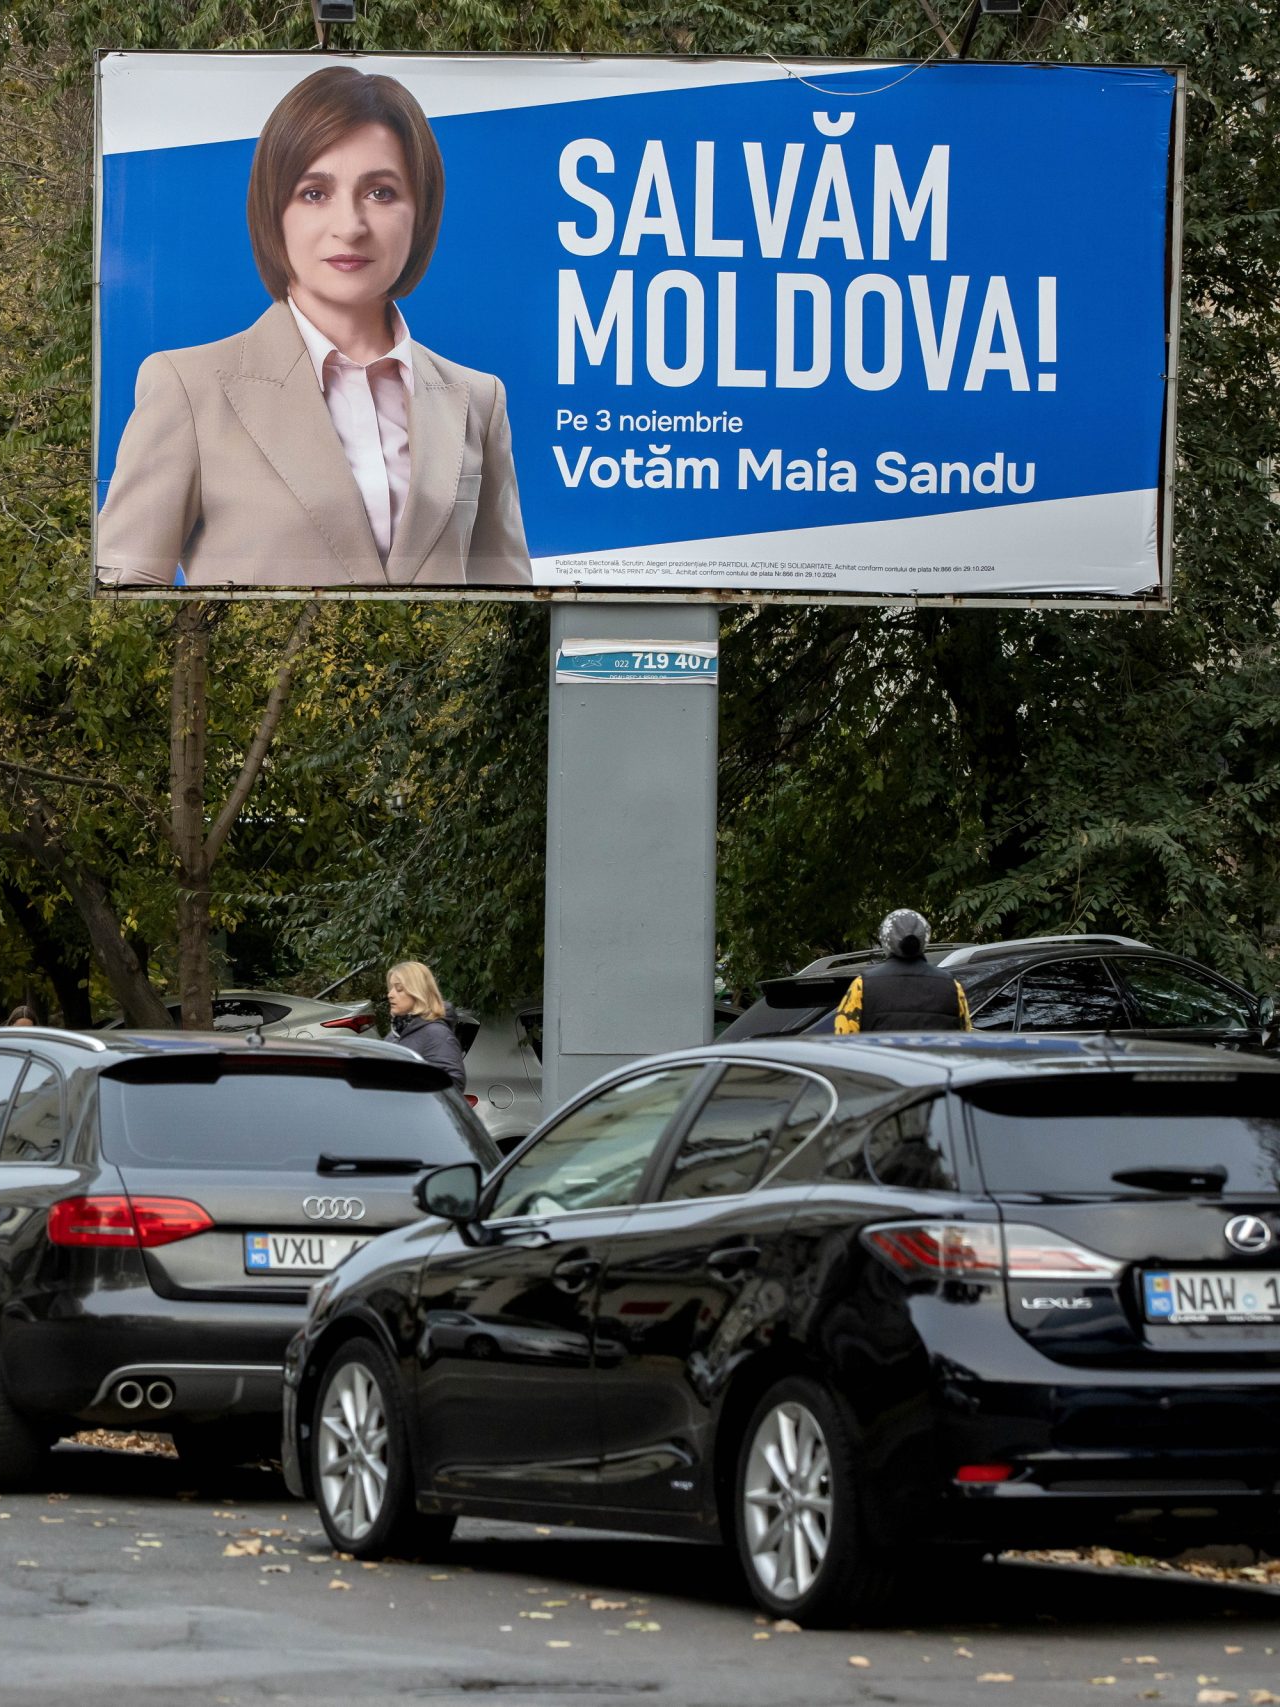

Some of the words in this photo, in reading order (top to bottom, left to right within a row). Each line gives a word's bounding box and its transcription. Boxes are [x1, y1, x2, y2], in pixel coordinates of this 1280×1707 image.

[557, 111, 950, 261] SALVĂM
[557, 269, 1057, 392] MOLDOVA!
[556, 409, 588, 431] Pe
[595, 410, 611, 432] 3
[619, 410, 743, 433] noiembrie
[552, 444, 719, 490] Votăm
[738, 447, 857, 492] Maia
[874, 452, 1036, 494] Sandu
[718, 561, 749, 569] PARTIDUL
[834, 563, 857, 571] Achitat
[857, 564, 884, 572] conform
[614, 660, 629, 668] 022
[632, 653, 669, 669] 719
[674, 653, 711, 669] 407
[272, 1237, 324, 1265] VXU
[1021, 1296, 1093, 1310] LEXUS
[1175, 1277, 1236, 1310] NAW
